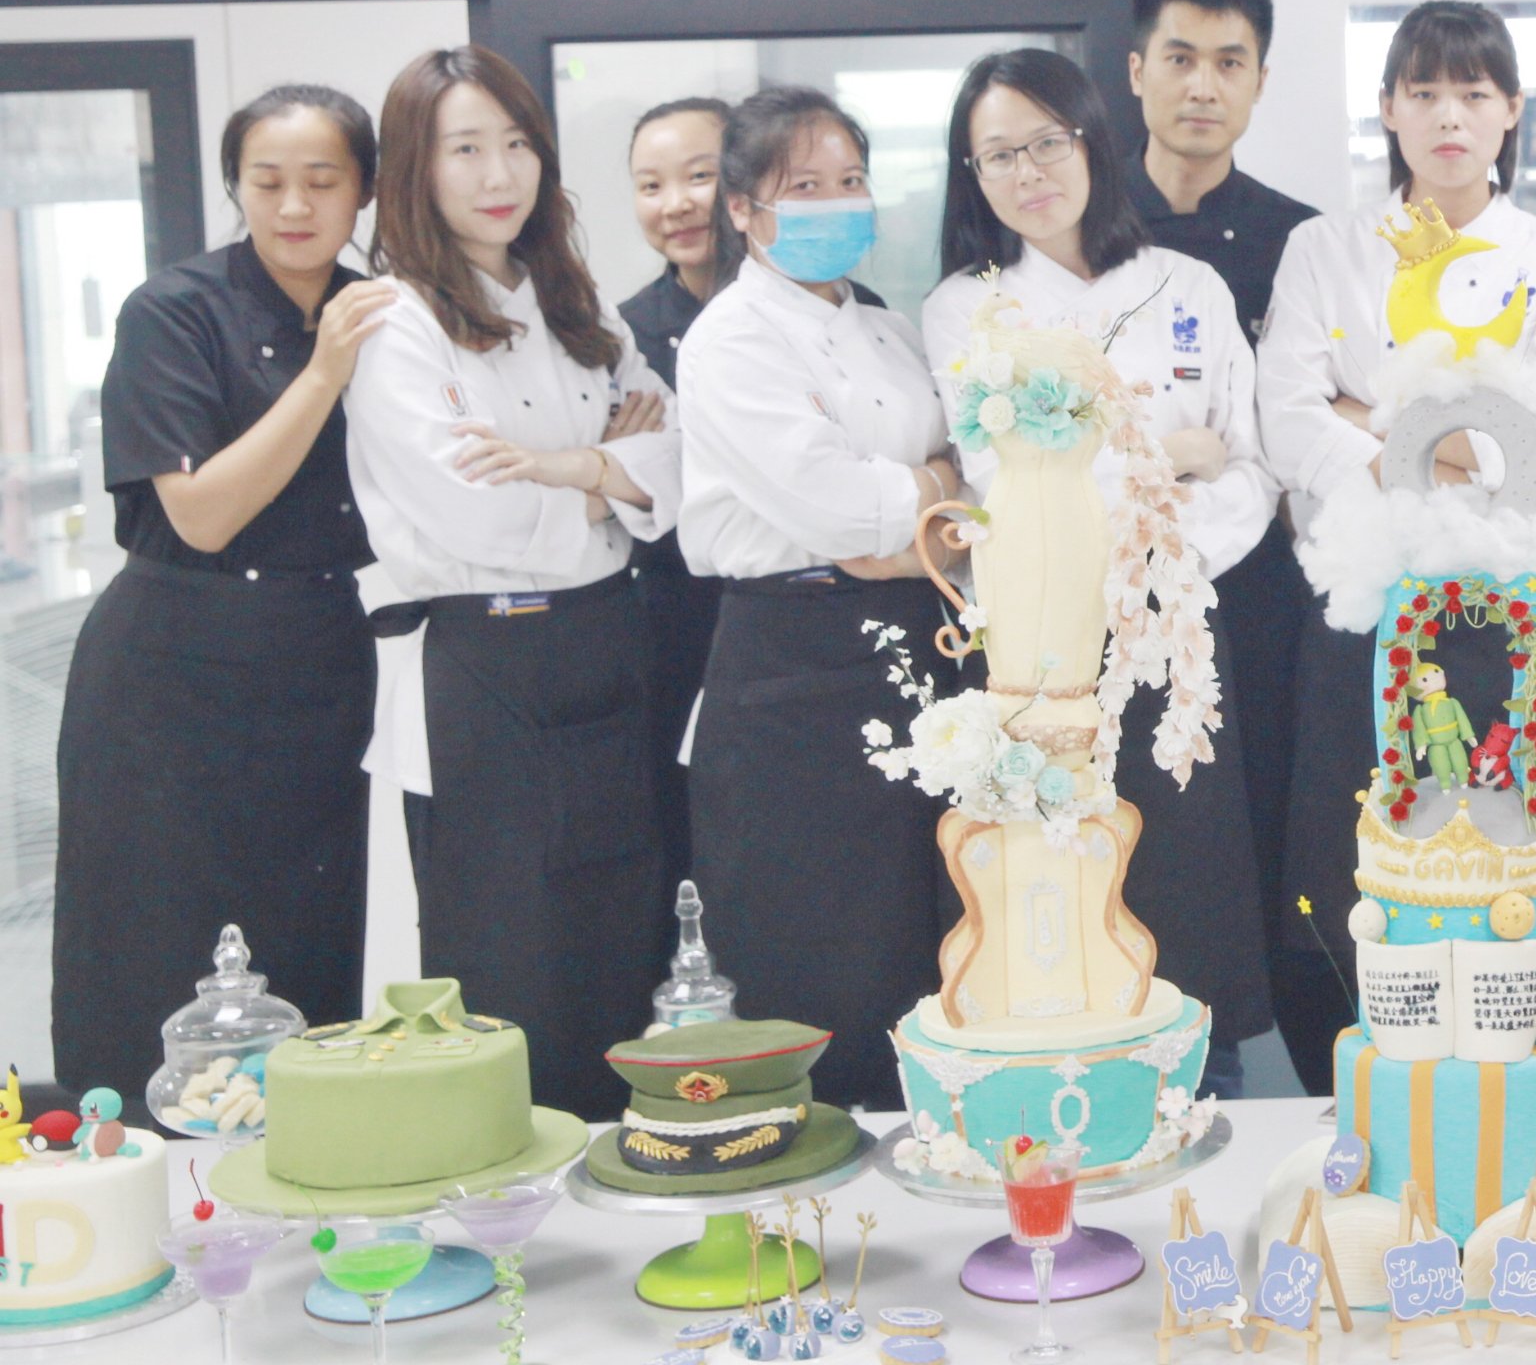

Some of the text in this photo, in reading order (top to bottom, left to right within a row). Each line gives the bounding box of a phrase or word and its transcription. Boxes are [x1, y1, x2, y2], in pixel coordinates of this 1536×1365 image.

[1414, 854, 1505, 884] GAVIN
[0, 1199, 94, 1284] D
[1175, 1255, 1234, 1300] Smile
[1390, 1258, 1463, 1305] Happy
